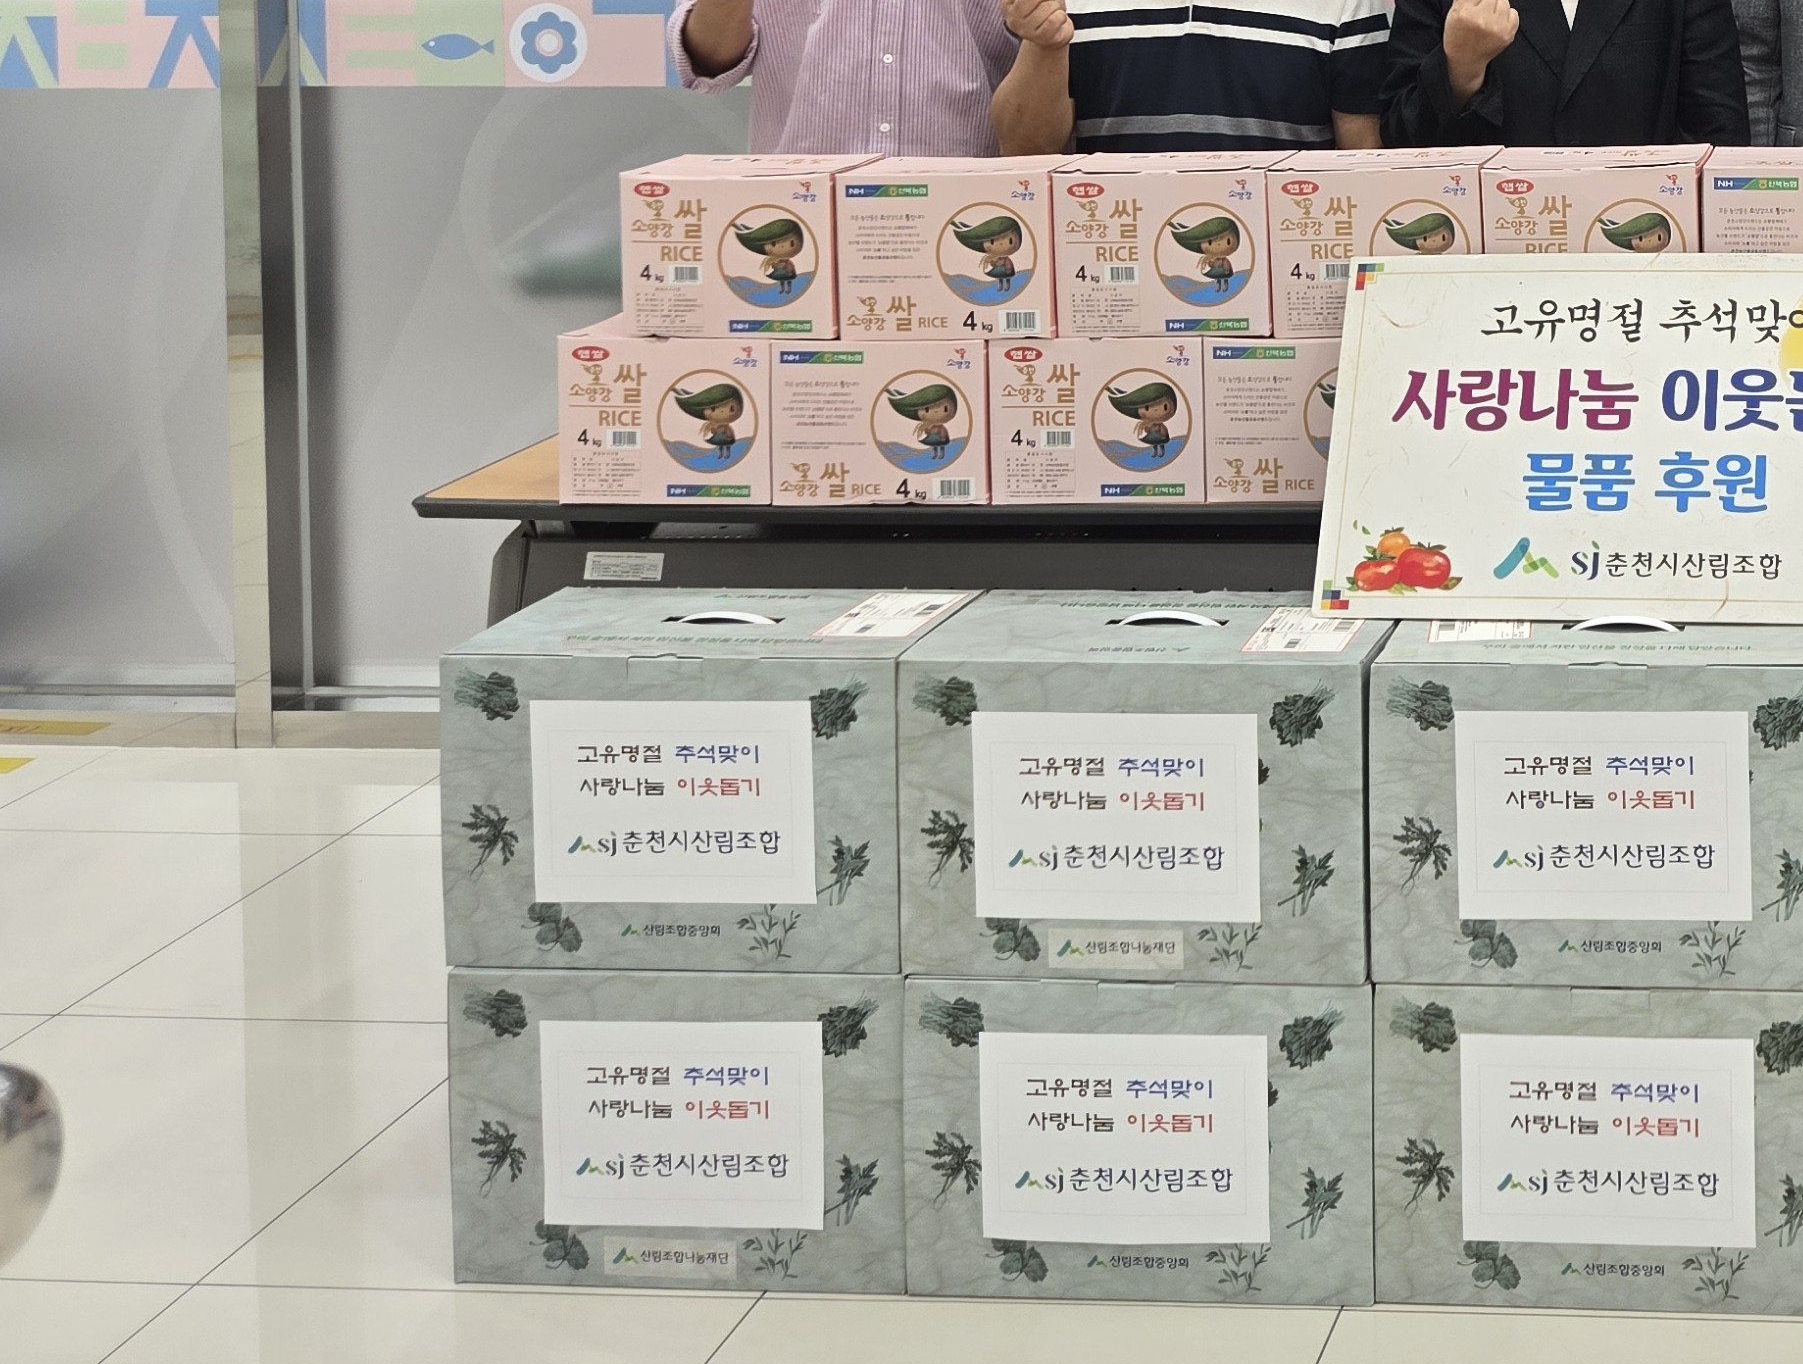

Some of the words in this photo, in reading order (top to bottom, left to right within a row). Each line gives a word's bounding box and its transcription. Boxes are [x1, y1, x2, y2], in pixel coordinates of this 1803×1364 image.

[631, 220, 673, 237] 소양강
[674, 199, 707, 238] 쌀
[660, 246, 702, 262] RICE
[1480, 297, 1643, 344] 고유명절
[1392, 369, 1639, 432] 사랑나눔
[1523, 451, 1635, 512] 물품
[1654, 451, 1769, 513] 후원
[577, 744, 662, 764] 고유명절
[675, 744, 760, 764] 추석맞이
[579, 777, 665, 797] 사랑나눔
[677, 777, 761, 797] 이웃돕기
[643, 923, 721, 938] 산림조합중앙회
